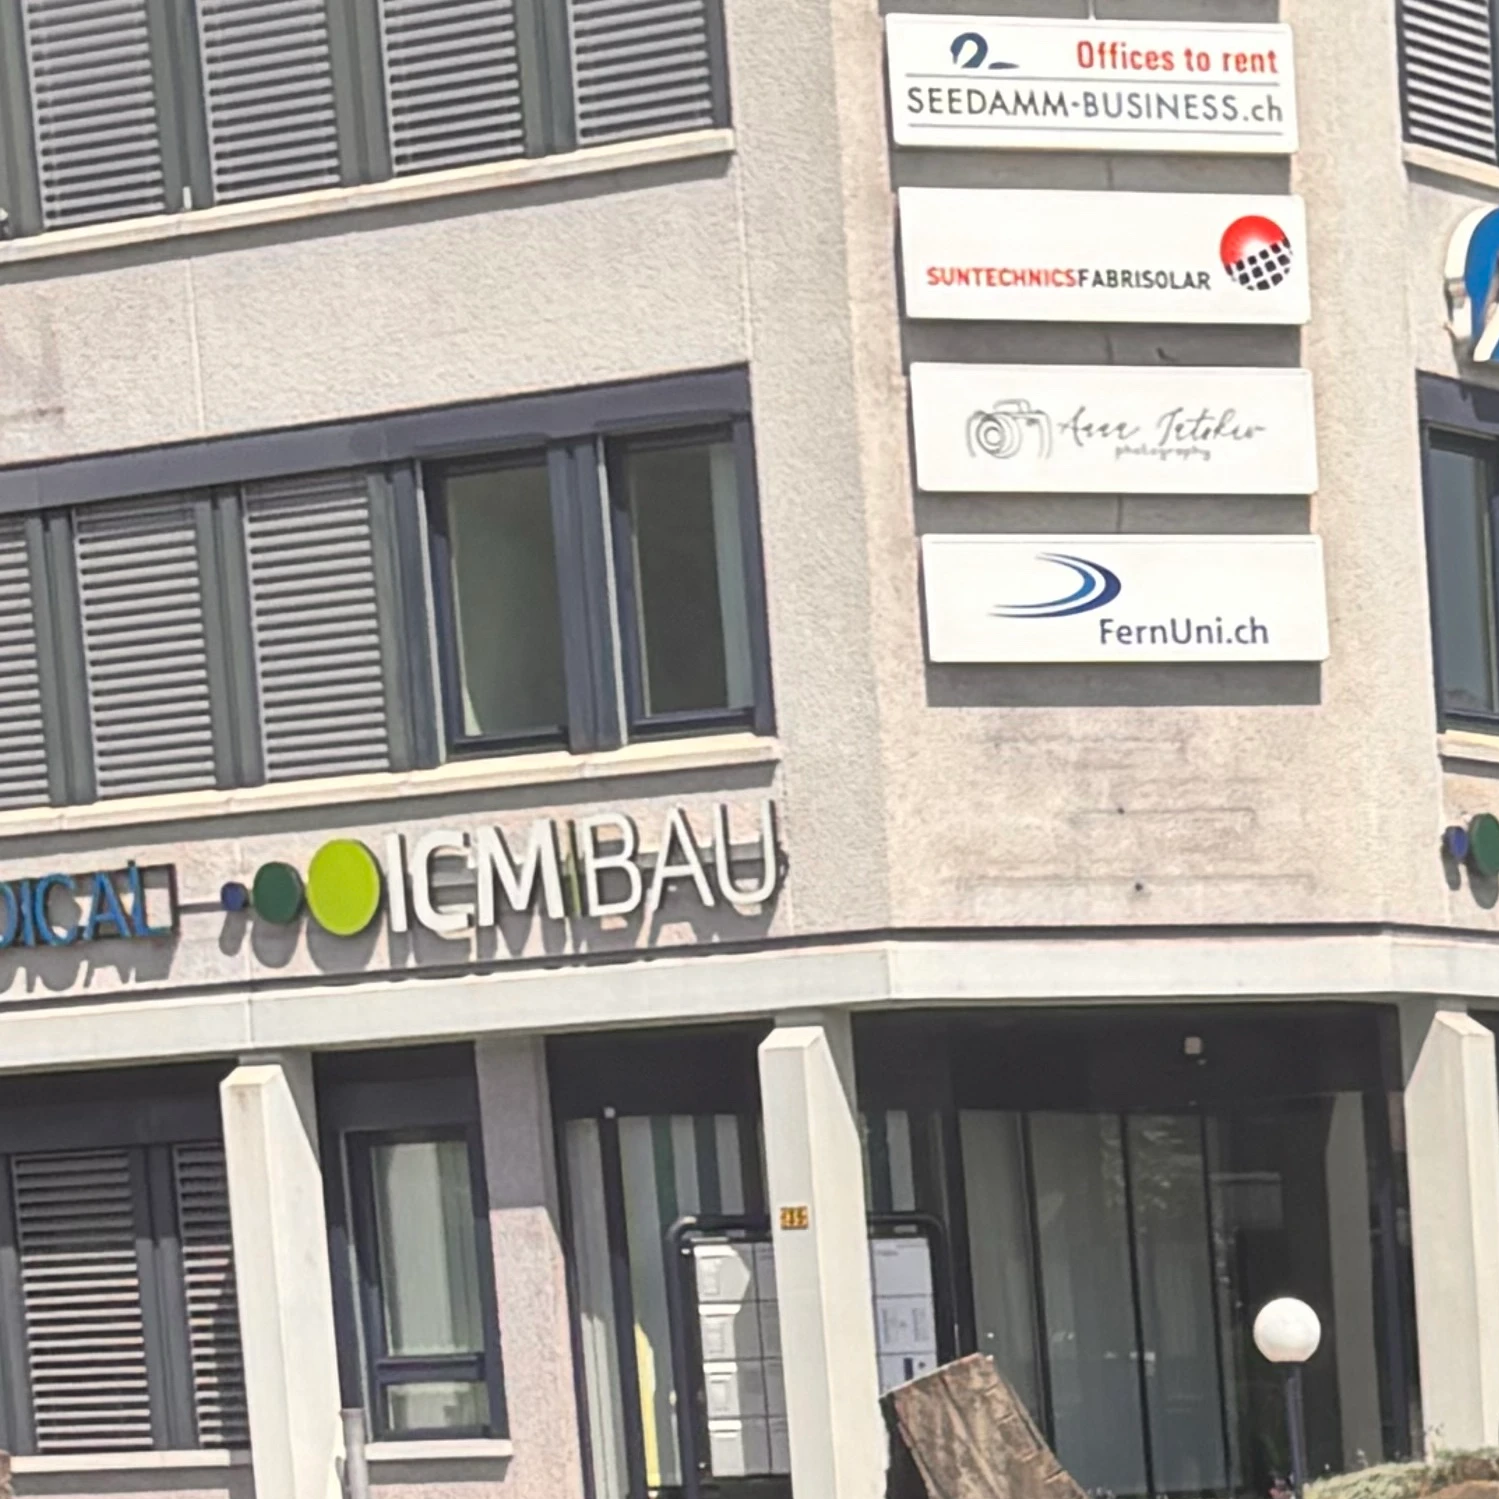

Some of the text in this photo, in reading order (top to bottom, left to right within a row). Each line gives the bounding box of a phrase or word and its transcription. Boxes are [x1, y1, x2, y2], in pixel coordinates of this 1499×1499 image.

[1076, 40, 1279, 74] Offices to rent
[906, 86, 1284, 122] SEEDAMM-BUSINESS.ch
[1099, 616, 1270, 645] FernUni.ch
